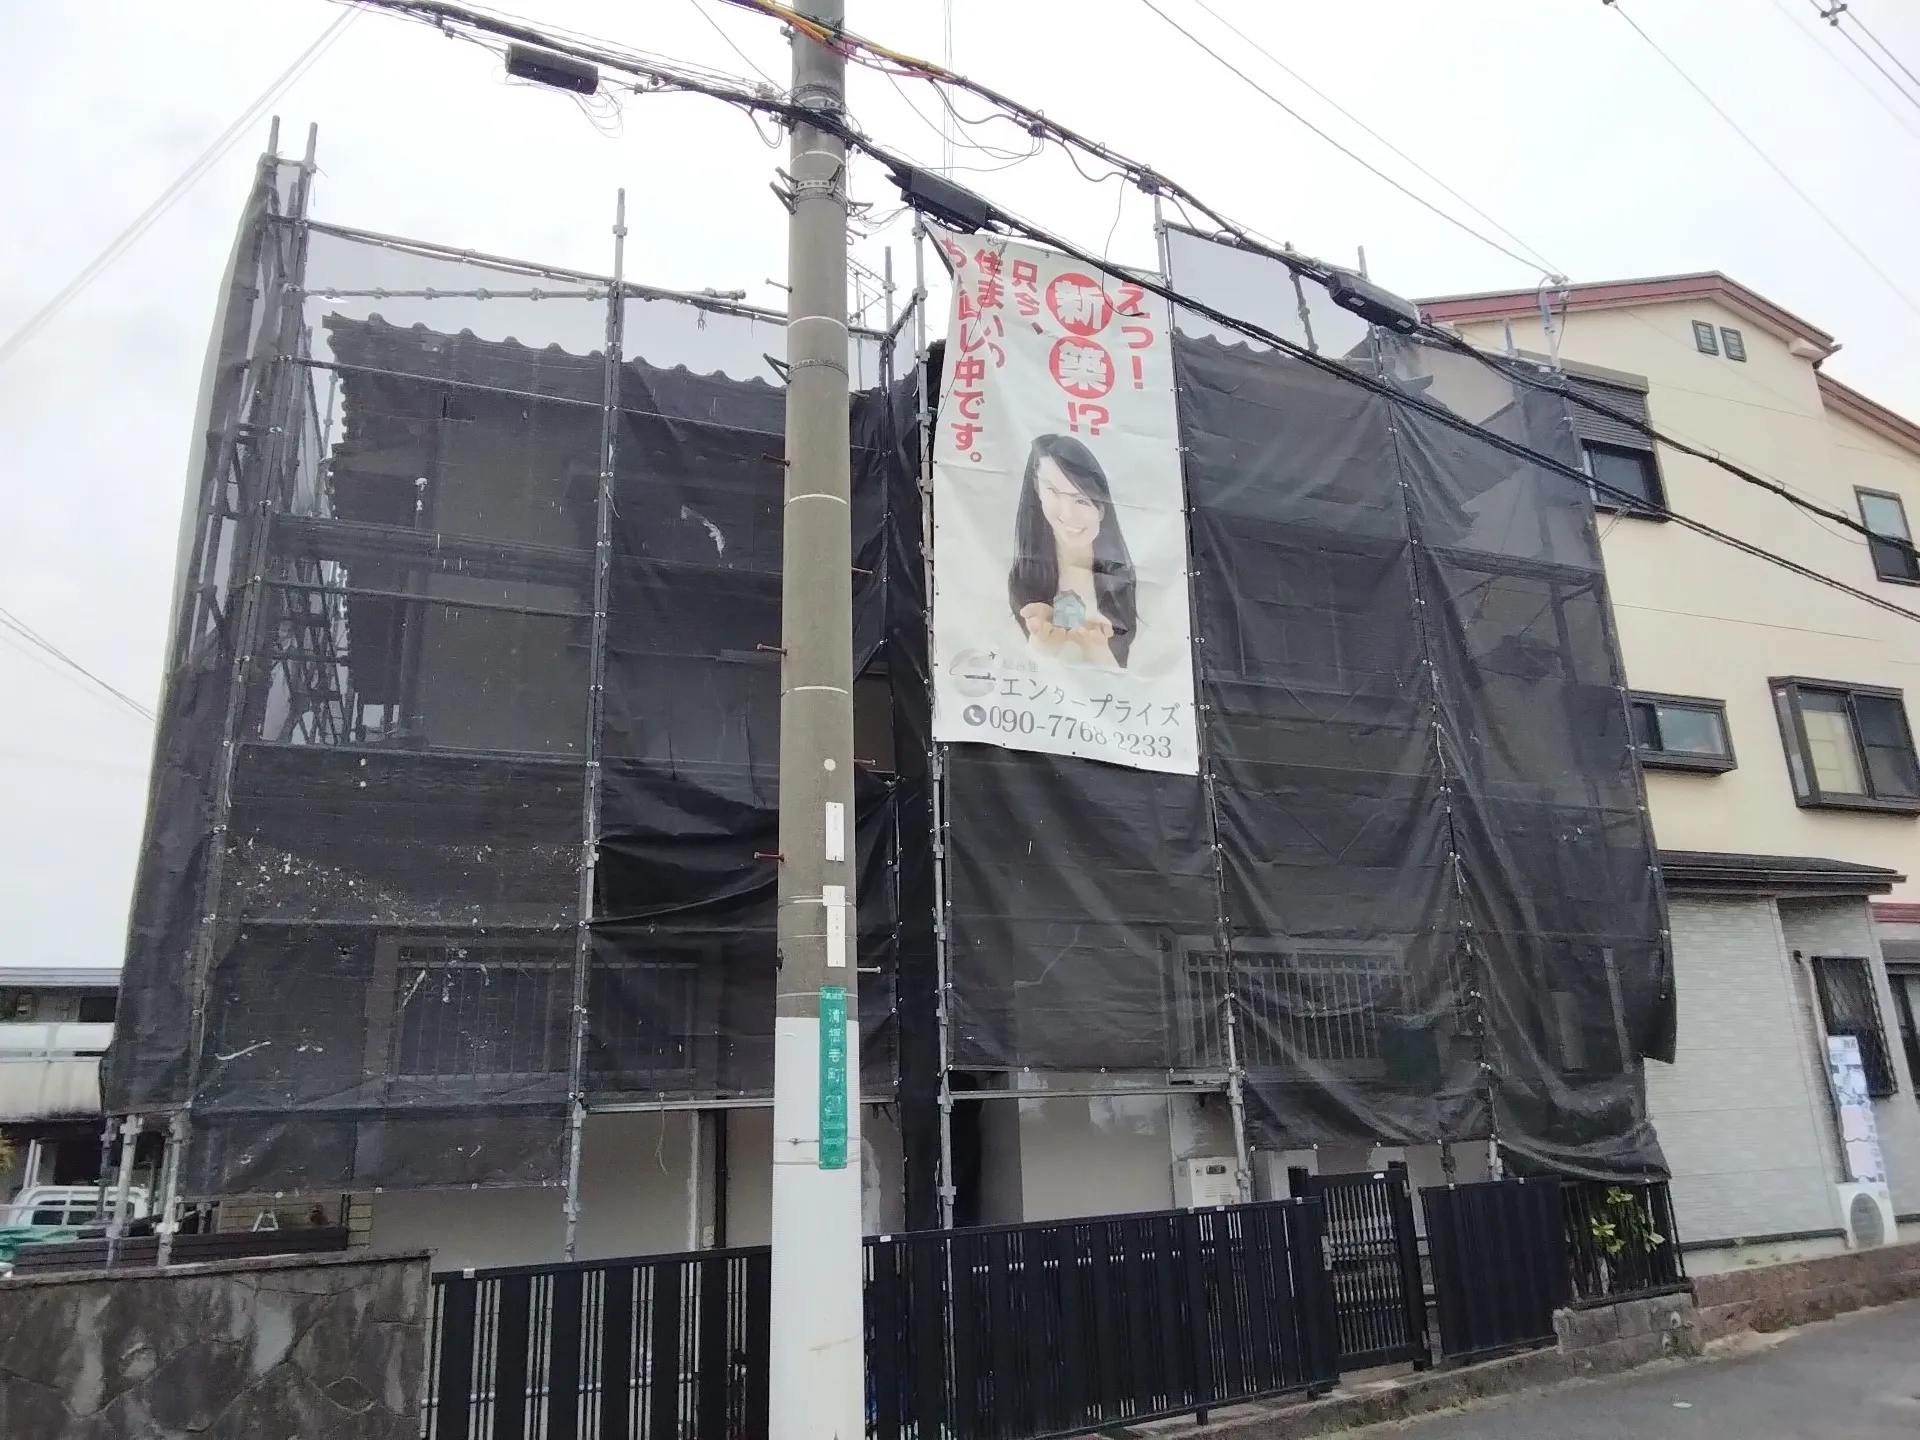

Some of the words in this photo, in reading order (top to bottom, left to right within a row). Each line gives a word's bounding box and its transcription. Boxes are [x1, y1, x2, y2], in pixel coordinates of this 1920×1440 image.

[1000, 677, 1181, 727] エンタープライズ
